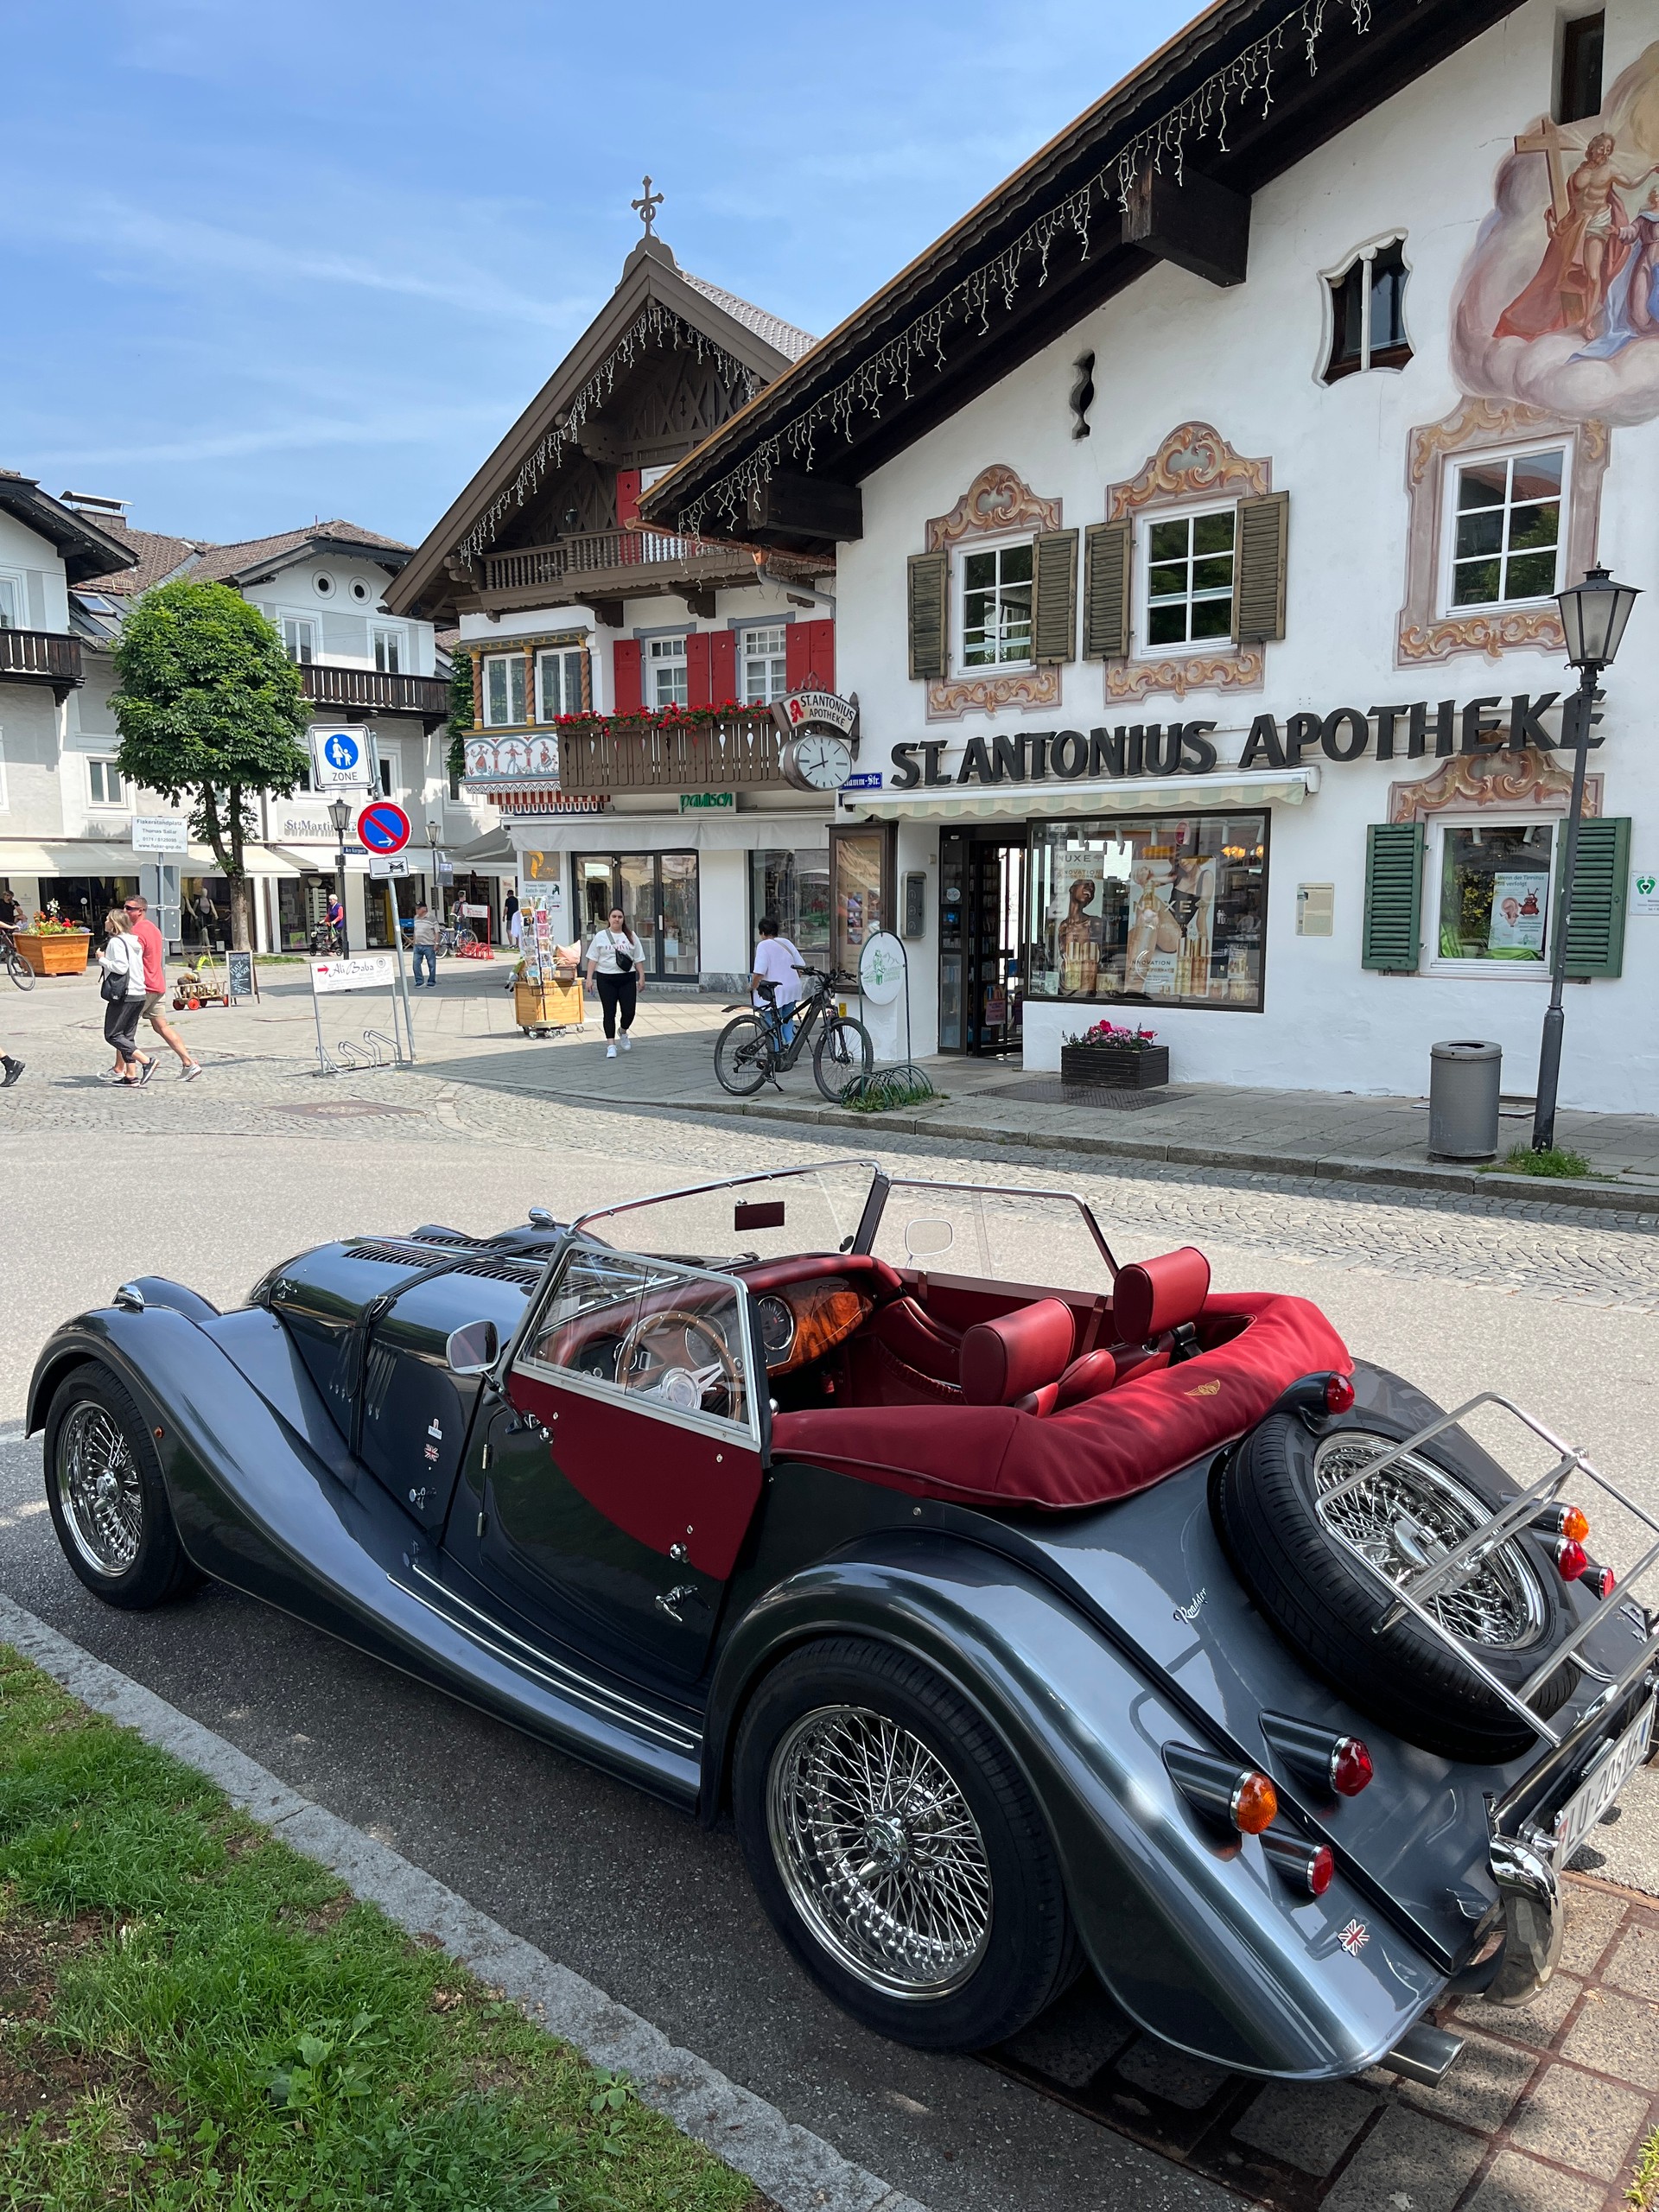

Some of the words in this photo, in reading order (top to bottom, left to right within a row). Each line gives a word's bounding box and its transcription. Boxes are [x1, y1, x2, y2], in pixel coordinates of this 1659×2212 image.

[809, 709, 846, 727] APOTHEKE
[1237, 689, 1606, 770] APOTHEKE
[333, 772, 359, 782] ZONE
[329, 963, 346, 977] Ali
[346, 961, 374, 976] Baba
[1174, 1587, 1208, 1624] Roadster
